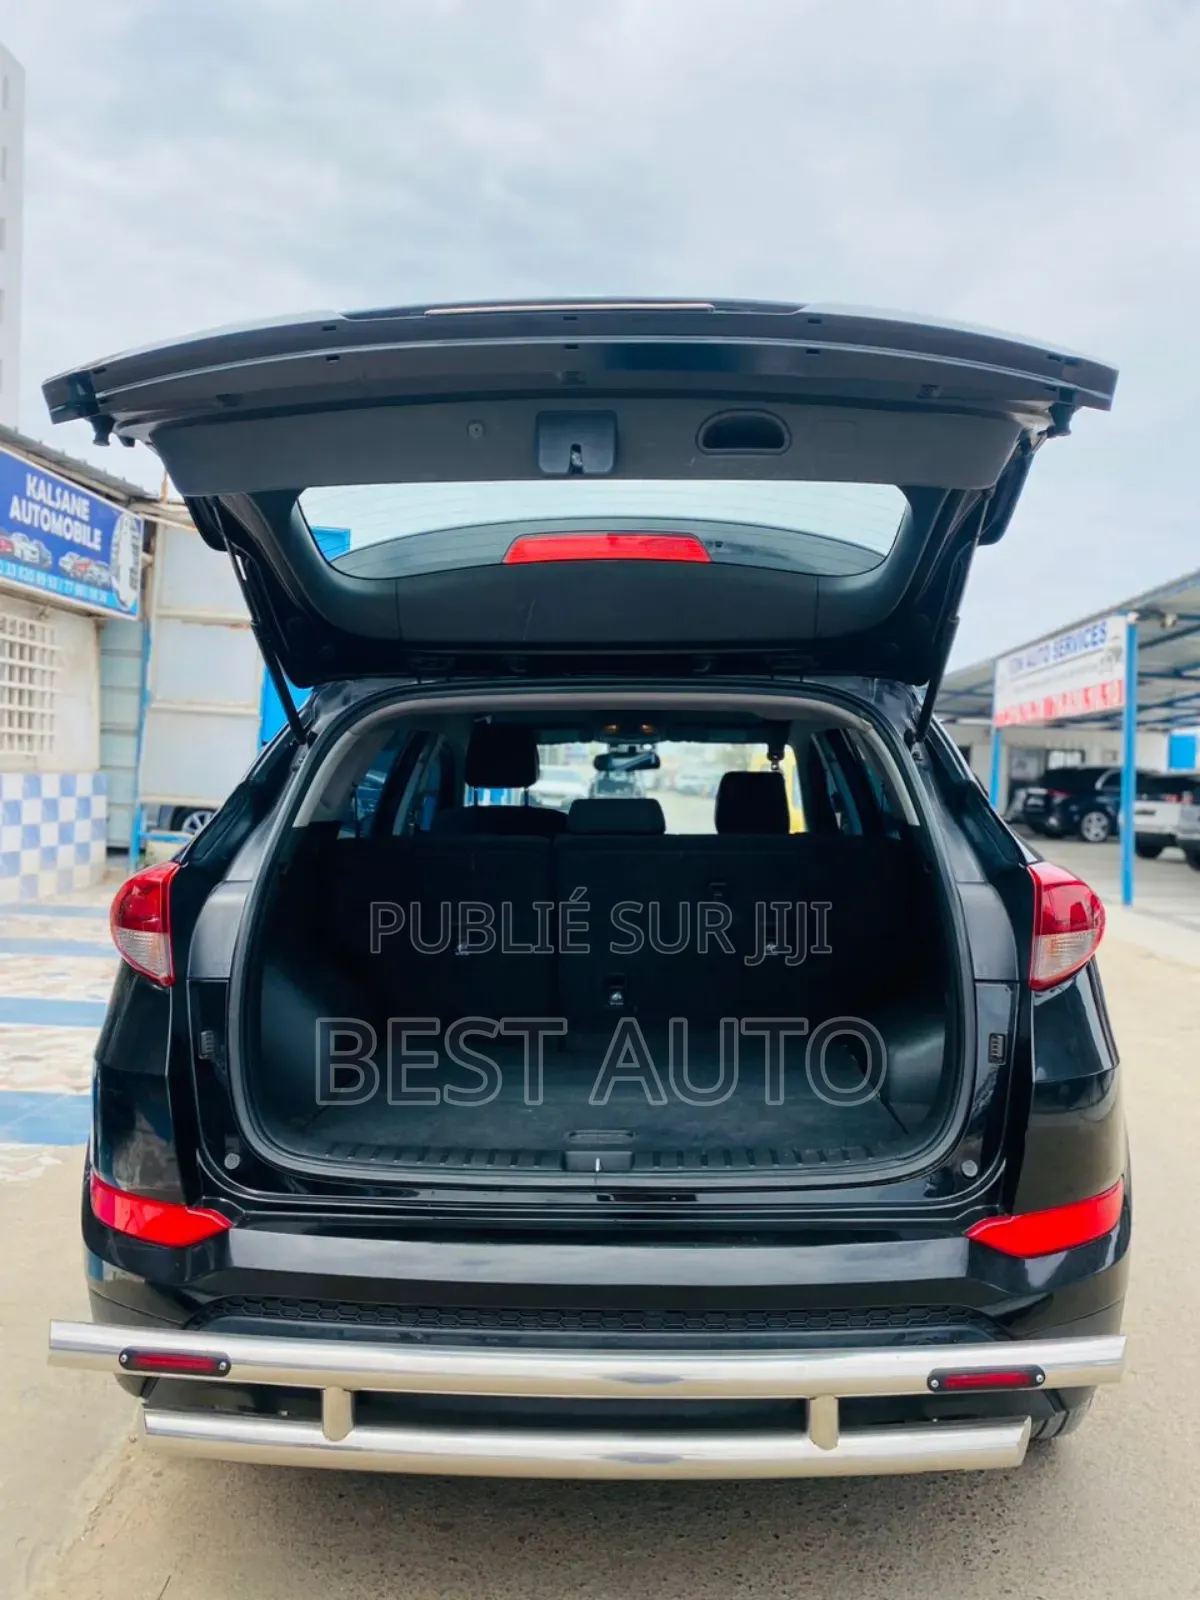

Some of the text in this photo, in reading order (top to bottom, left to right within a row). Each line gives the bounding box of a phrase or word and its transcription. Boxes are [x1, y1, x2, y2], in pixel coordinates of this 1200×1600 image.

[26, 473, 90, 521] KALSANE
[10, 496, 102, 550] AUTOMOBILE
[1053, 620, 1107, 660] SERVICES
